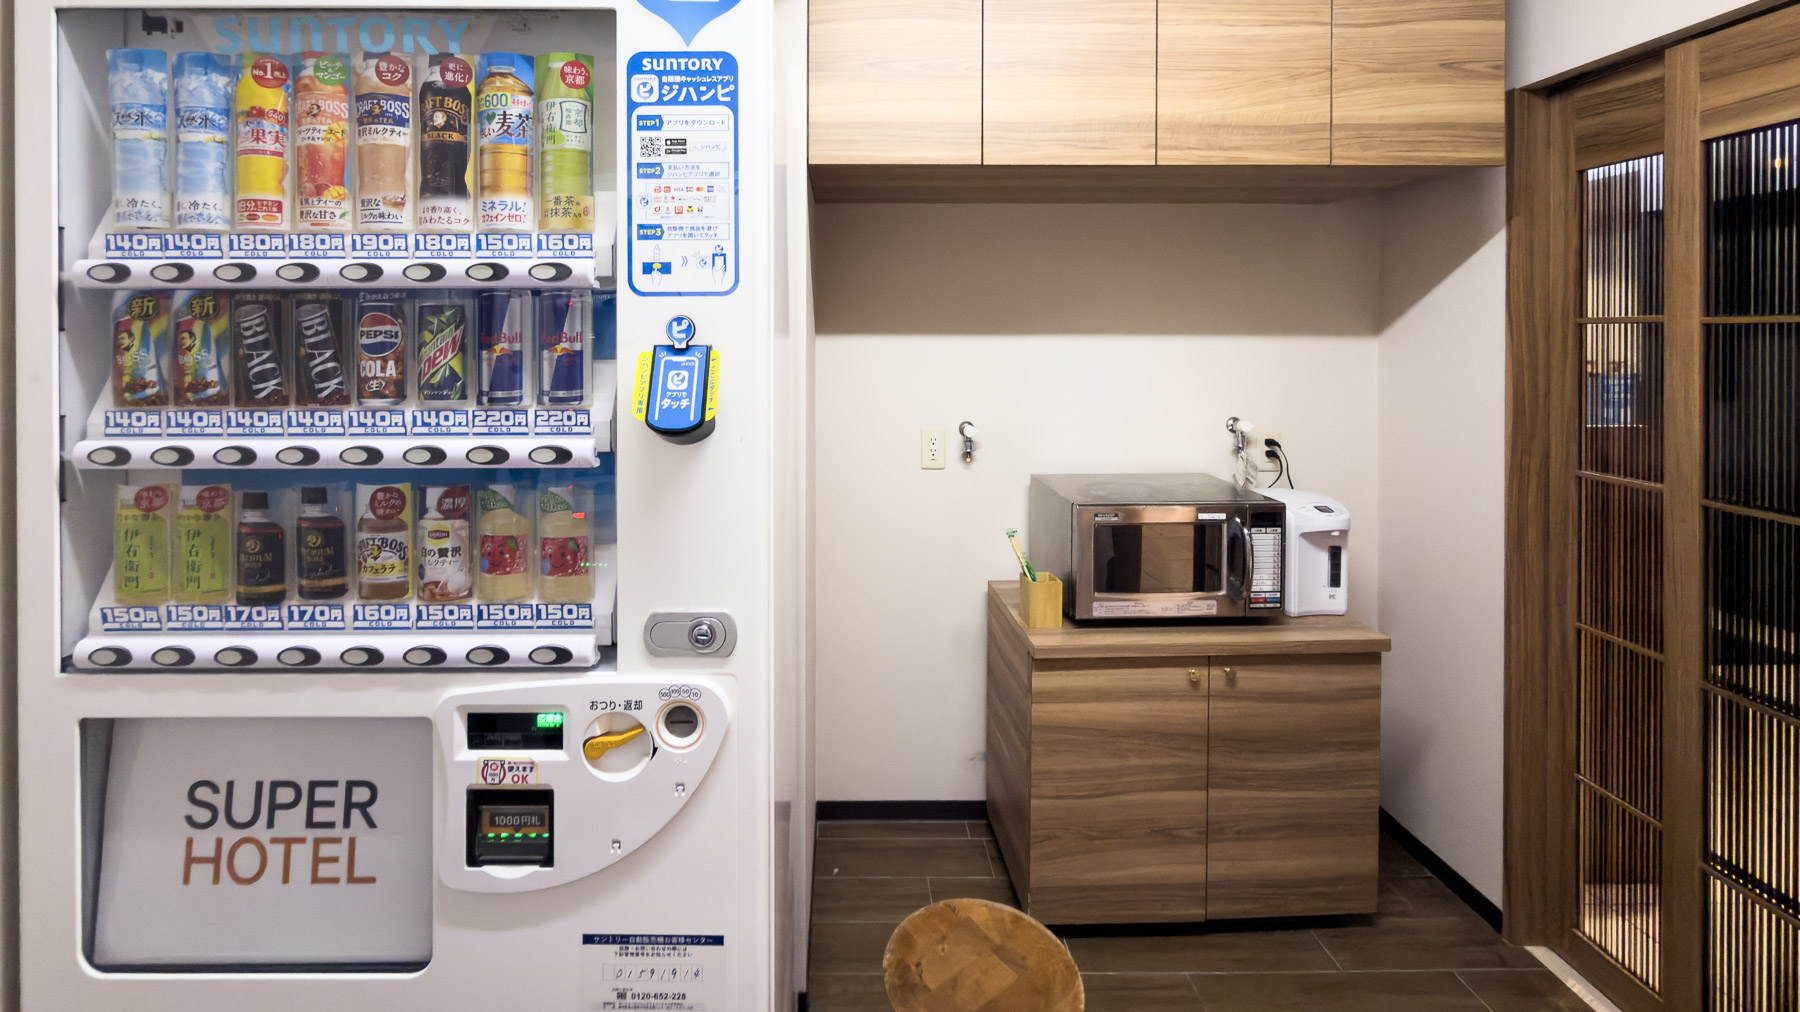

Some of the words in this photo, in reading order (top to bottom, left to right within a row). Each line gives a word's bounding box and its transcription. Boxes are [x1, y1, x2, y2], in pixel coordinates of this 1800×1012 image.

[215, 15, 471, 54] SUNTORY
[642, 58, 723, 71] SUNTORY
[381, 72, 402, 81] コク
[565, 75, 586, 85] 京都
[484, 93, 508, 107] 600
[662, 84, 735, 102] ジハンピ
[380, 100, 409, 119] BOSS
[481, 200, 527, 213] ミネラル!
[482, 213, 527, 223] カフェインゼロ!
[107, 235, 160, 250] 140円
[165, 235, 219, 250] 140円
[230, 235, 283, 250] 180円
[290, 235, 343, 250] 180円
[353, 235, 406, 250] 190円
[417, 235, 469, 250] 180円
[478, 235, 531, 250] 150円
[539, 235, 591, 250] 160円
[131, 298, 155, 317] 新
[191, 297, 215, 316] 新
[360, 330, 399, 340] PEPSI
[672, 319, 689, 338] ピ
[240, 315, 283, 399] BLACK
[301, 314, 345, 398] BLACK
[360, 360, 397, 377] COLA
[661, 399, 690, 409] タッチ
[107, 411, 160, 426] 140円
[168, 411, 221, 426] 140円
[228, 411, 280, 426] 140円
[288, 411, 341, 426] 140円
[350, 411, 401, 426] 140円
[414, 411, 466, 426] 140円
[474, 411, 527, 426] 220円
[536, 411, 588, 426] 220円
[378, 537, 408, 560] BOSS
[361, 563, 396, 575] カフェラテ
[103, 608, 158, 623] 150円
[168, 606, 221, 621] 150円
[228, 606, 280, 621] 170円
[290, 606, 343, 621] 170円
[355, 605, 408, 620] 160円
[419, 605, 472, 620] 150円
[480, 605, 532, 620] 150円
[538, 605, 590, 620] 150円
[590, 700, 643, 711] おつり・返却
[511, 774, 529, 784] OK
[184, 779, 378, 830] SUPER
[495, 816, 541, 826] 1000円札
[182, 836, 377, 886] HOTEL
[631, 992, 687, 1000] 0120-652-228
